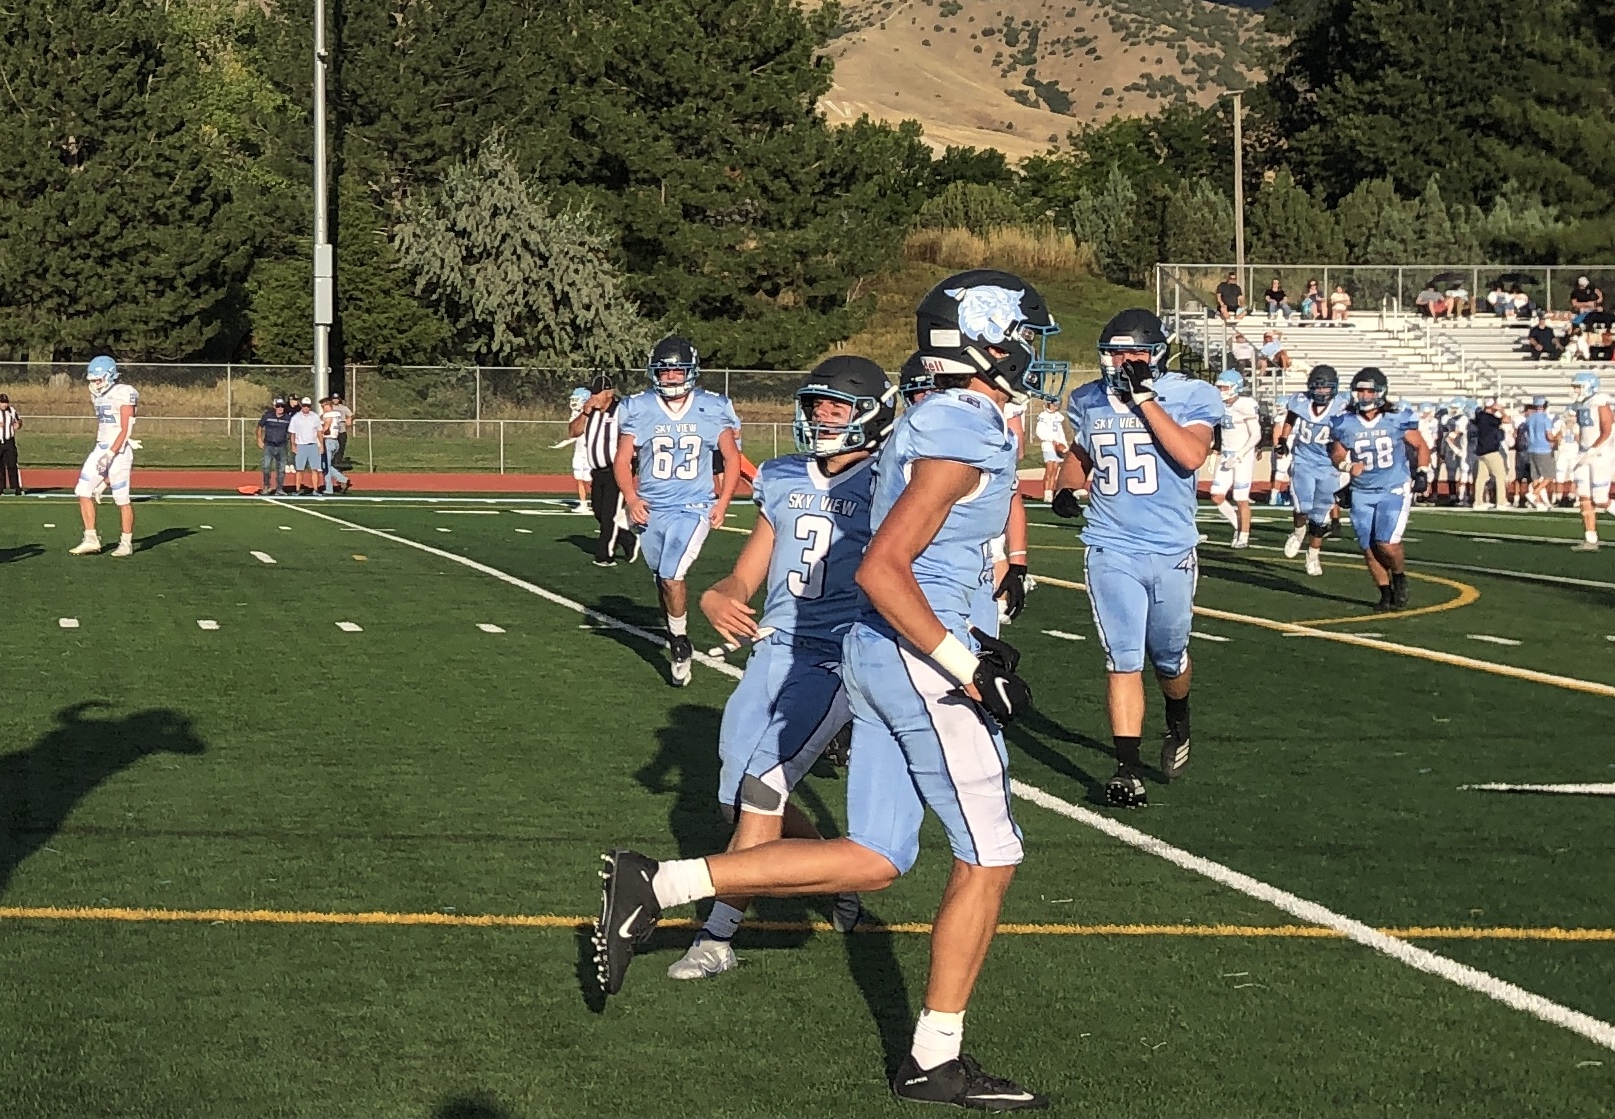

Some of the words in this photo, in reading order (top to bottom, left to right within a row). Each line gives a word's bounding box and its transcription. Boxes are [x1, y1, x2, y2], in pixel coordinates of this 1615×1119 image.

[654, 424, 671, 434] SKY
[676, 423, 697, 433] VIEW
[1093, 417, 1114, 429] SKY
[651, 435, 703, 480] 63
[1089, 431, 1160, 497] 55
[1354, 436, 1394, 471] 58
[788, 493, 815, 509] SKY
[819, 496, 857, 518] VIEW
[786, 513, 835, 600] 3
